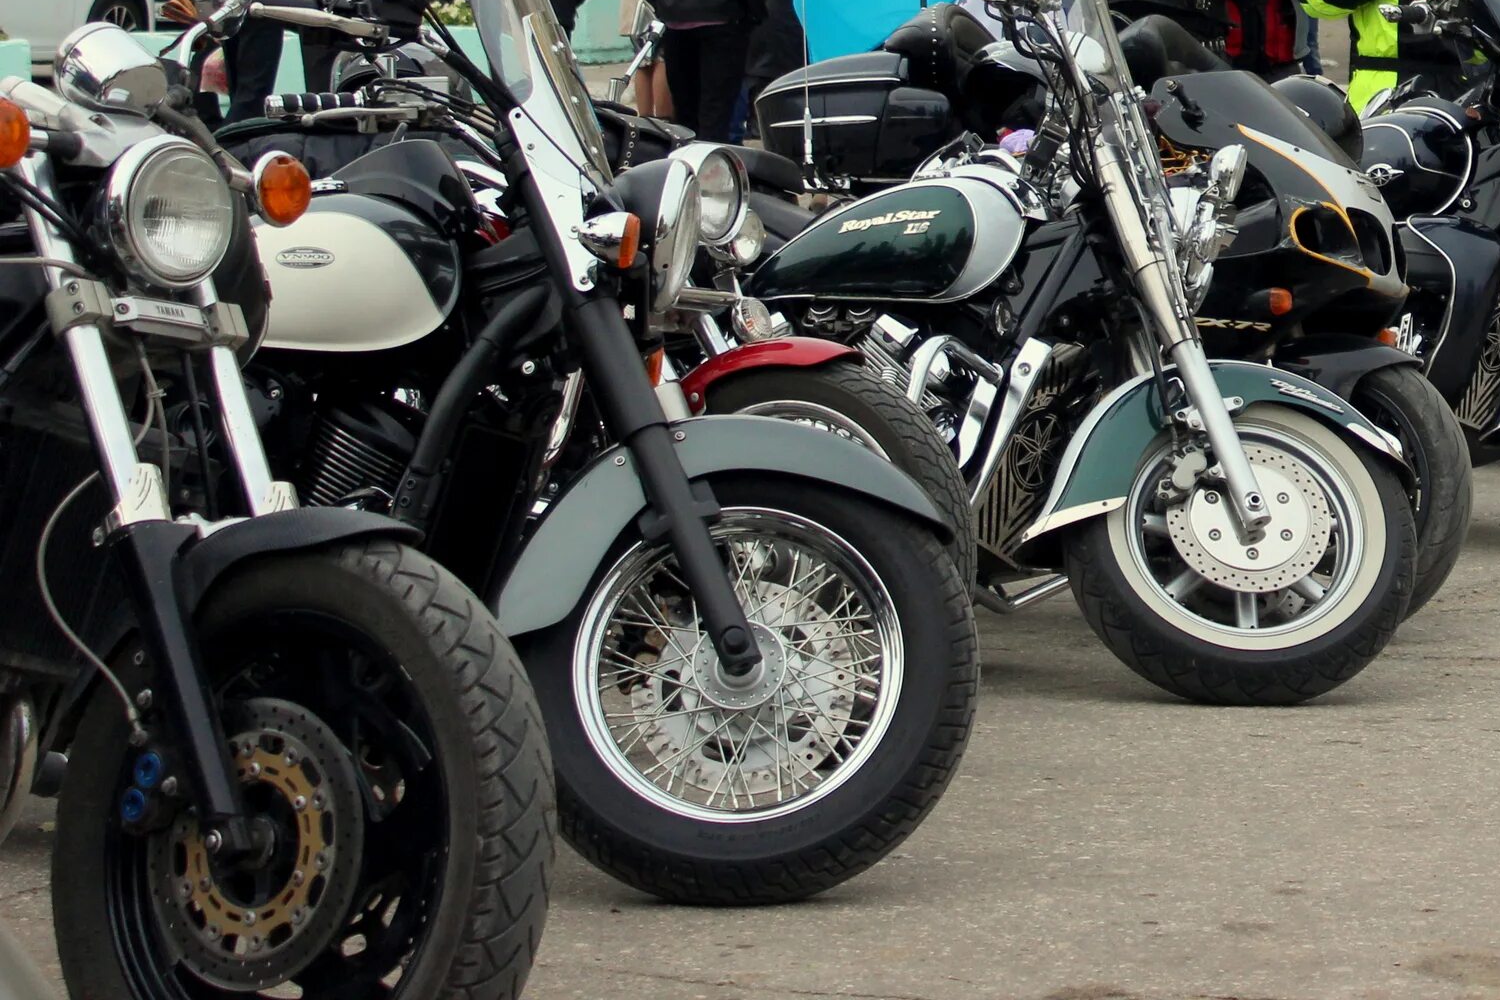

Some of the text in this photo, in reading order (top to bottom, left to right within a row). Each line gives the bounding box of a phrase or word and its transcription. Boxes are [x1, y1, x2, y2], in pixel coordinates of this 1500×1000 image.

[838, 209, 942, 234] Royal Star
[156, 304, 186, 319] YAMAHA
